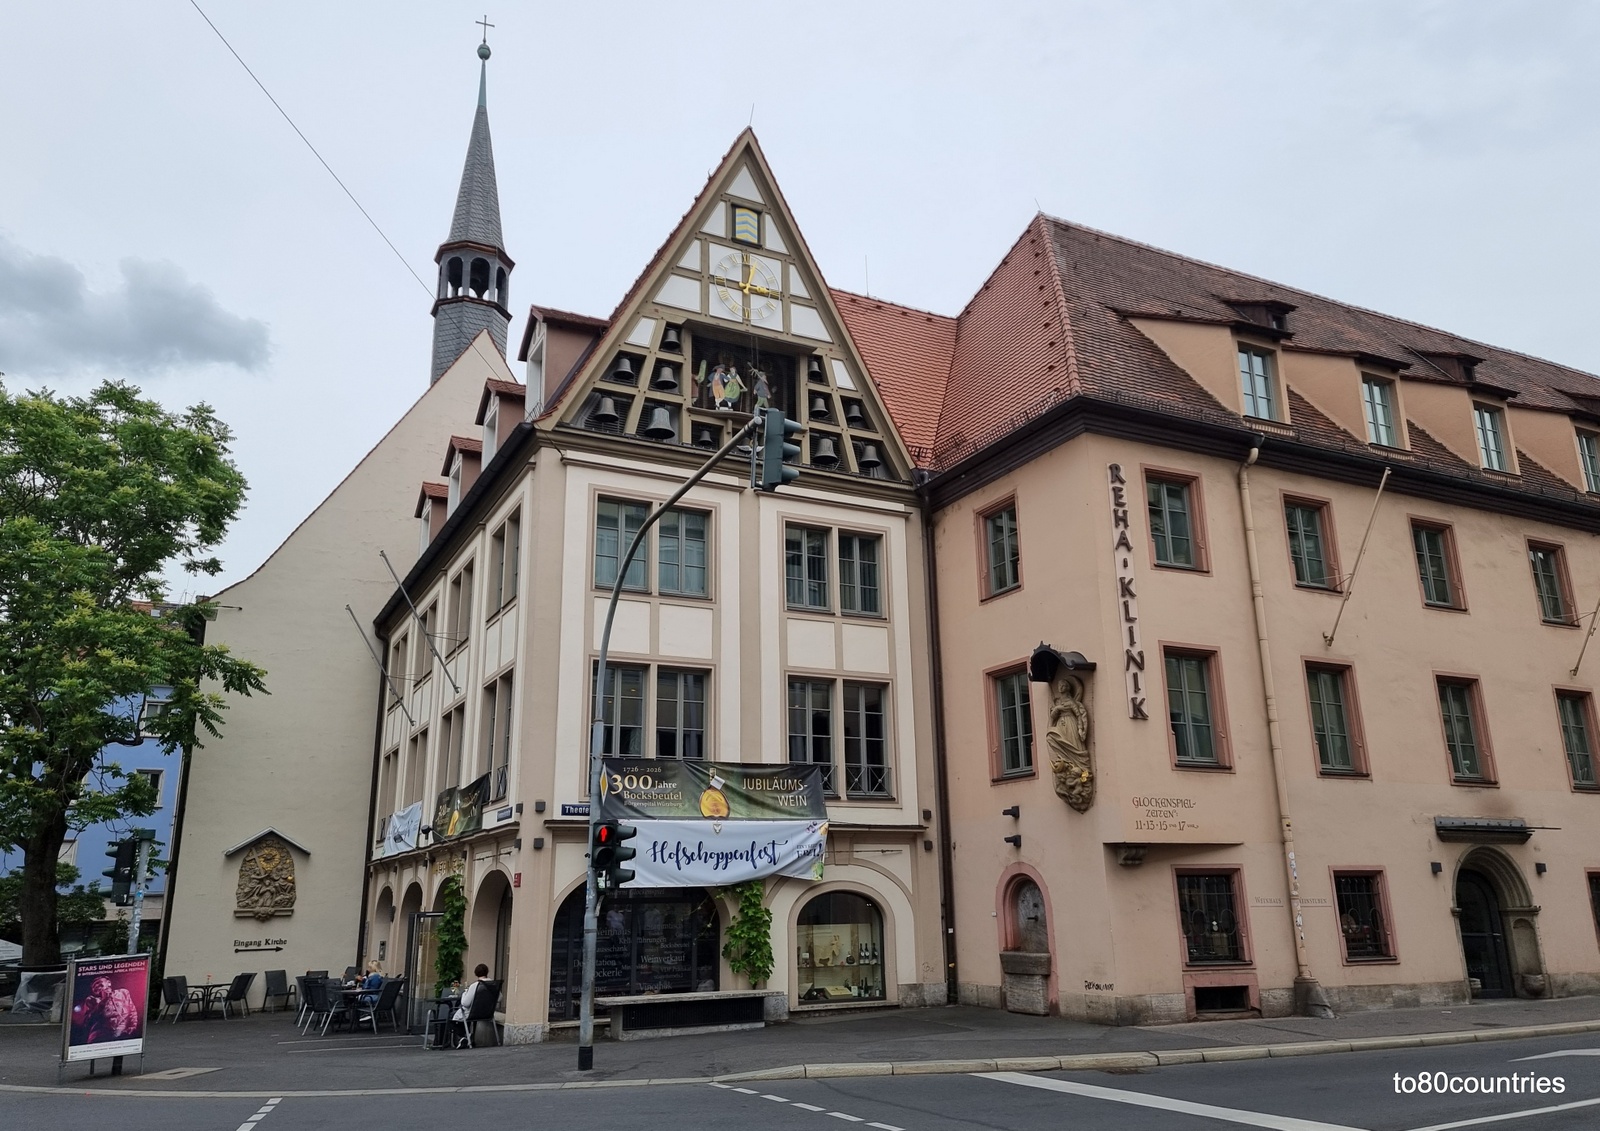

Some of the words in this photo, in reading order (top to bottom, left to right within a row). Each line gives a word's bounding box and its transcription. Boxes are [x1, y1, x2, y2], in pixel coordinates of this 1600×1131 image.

[610, 774, 653, 795] 300
[654, 780, 678, 790] Jahre
[742, 776, 808, 792] JUBILÄUMS-
[623, 790, 682, 800] Bocksbeutel
[777, 795, 808, 807] WEIN
[565, 805, 590, 814] Theate
[645, 839, 789, 871] Hofschoppenfest
[233, 939, 262, 948] Eingang
[264, 938, 288, 946] Kirche
[78, 965, 98, 973] STARS
[114, 961, 146, 969] LEGENDEN
[595, 967, 623, 977] ockerle
